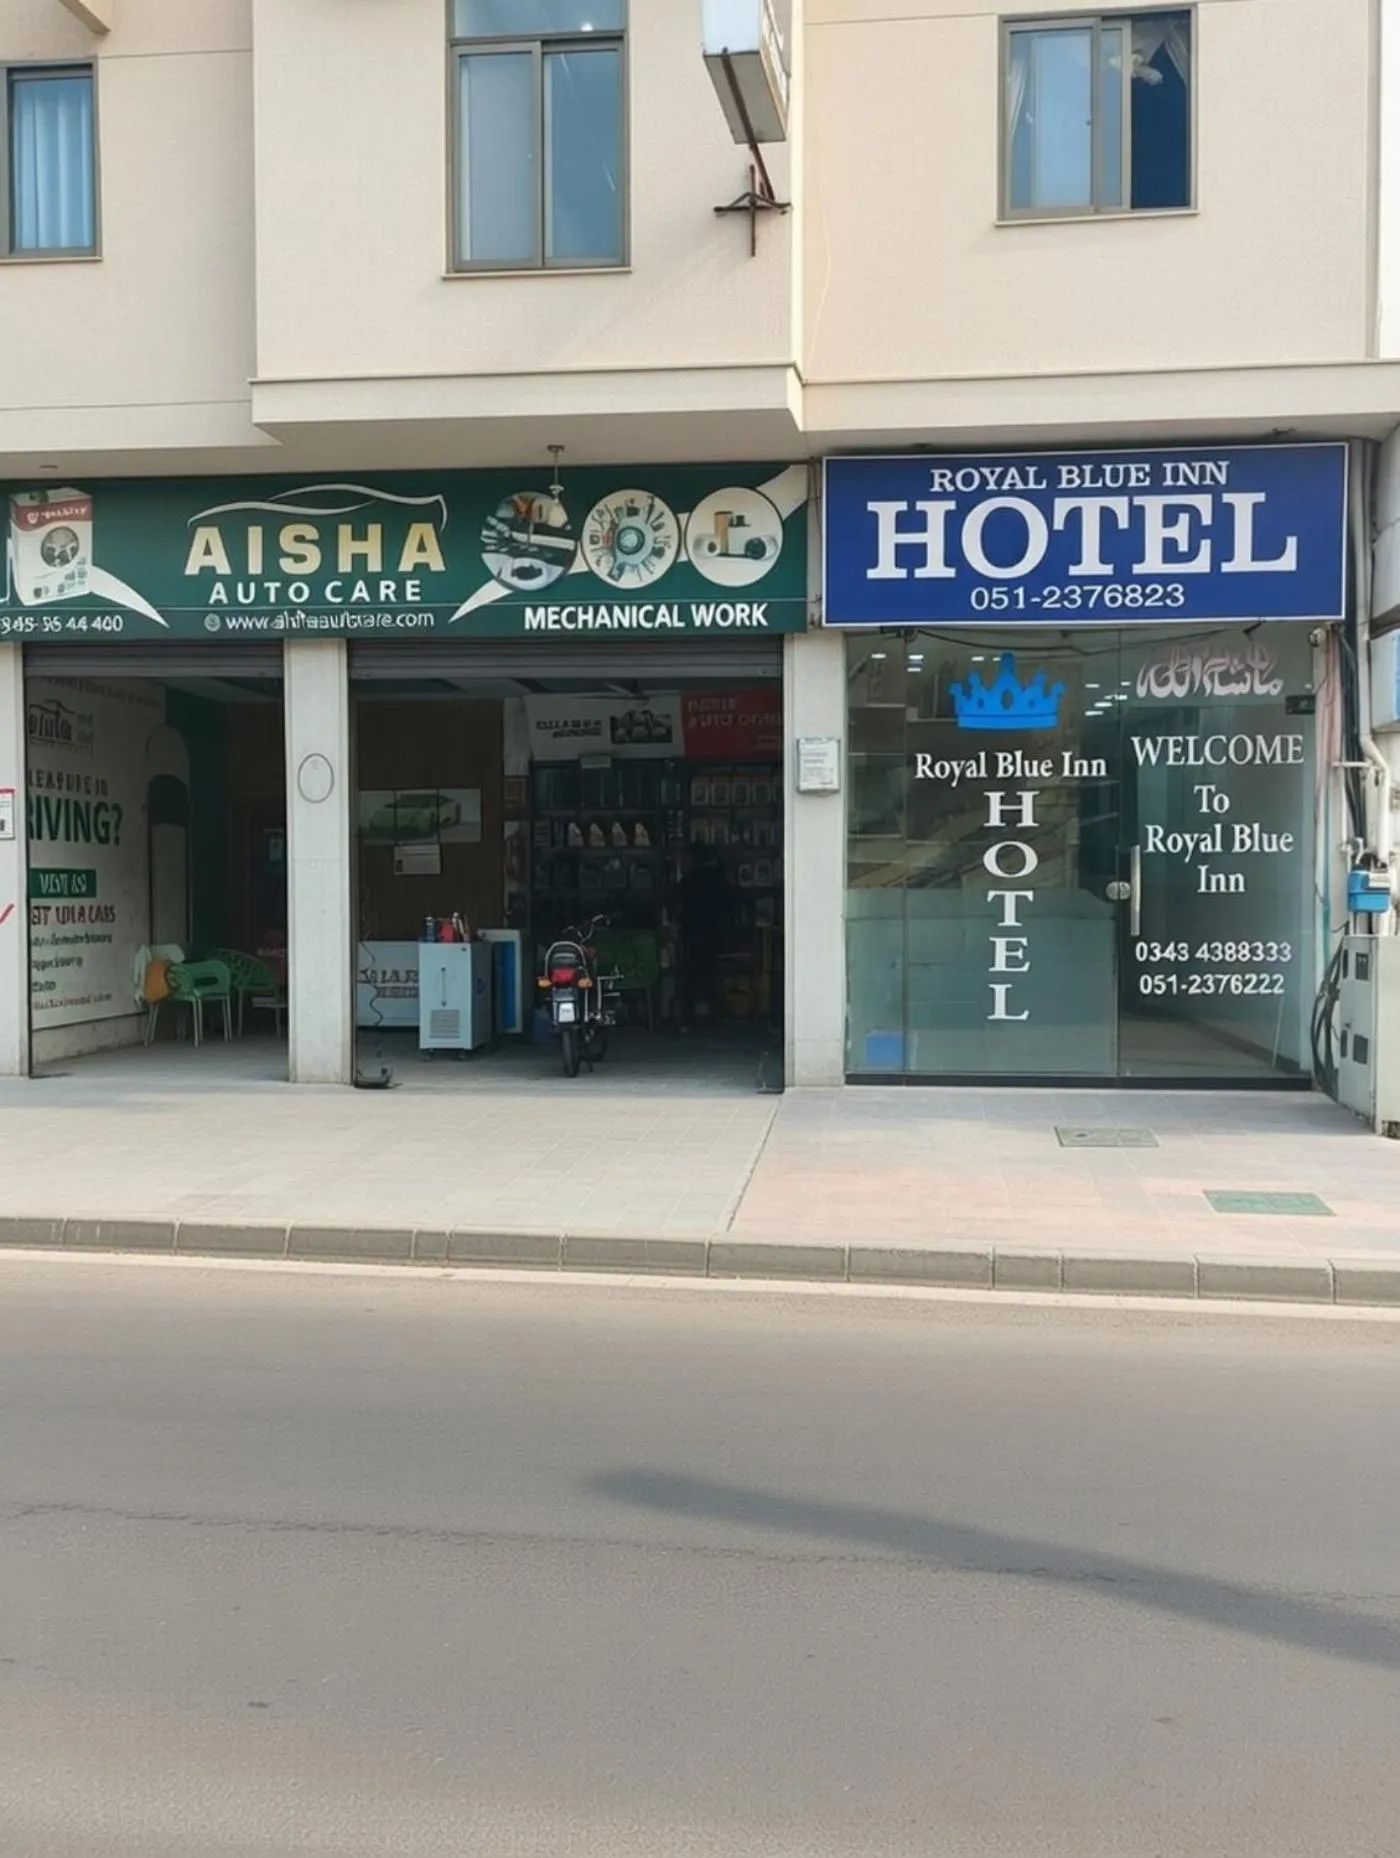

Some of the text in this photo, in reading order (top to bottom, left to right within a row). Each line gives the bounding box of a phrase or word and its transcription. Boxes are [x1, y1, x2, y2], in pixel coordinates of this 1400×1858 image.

[930, 461, 1230, 492] ROYAL BLUE INN
[184, 523, 446, 576] AISHA
[866, 493, 1298, 579] HOTEL
[209, 580, 421, 605] AUTO CARE
[970, 583, 1185, 610] 051-2376823
[524, 603, 768, 630] MECHANICAL WORK
[1131, 734, 1304, 767] WELCOME
[915, 749, 1107, 787] Royal Blue Inn
[1193, 784, 1230, 814] To
[1145, 822, 1294, 863] Royal Blue
[1198, 864, 1245, 894] Inn
[983, 791, 1040, 1021] HOTEL
[1135, 941, 1292, 963] 0343 4388333
[1139, 973, 1285, 995] 051-2376222
